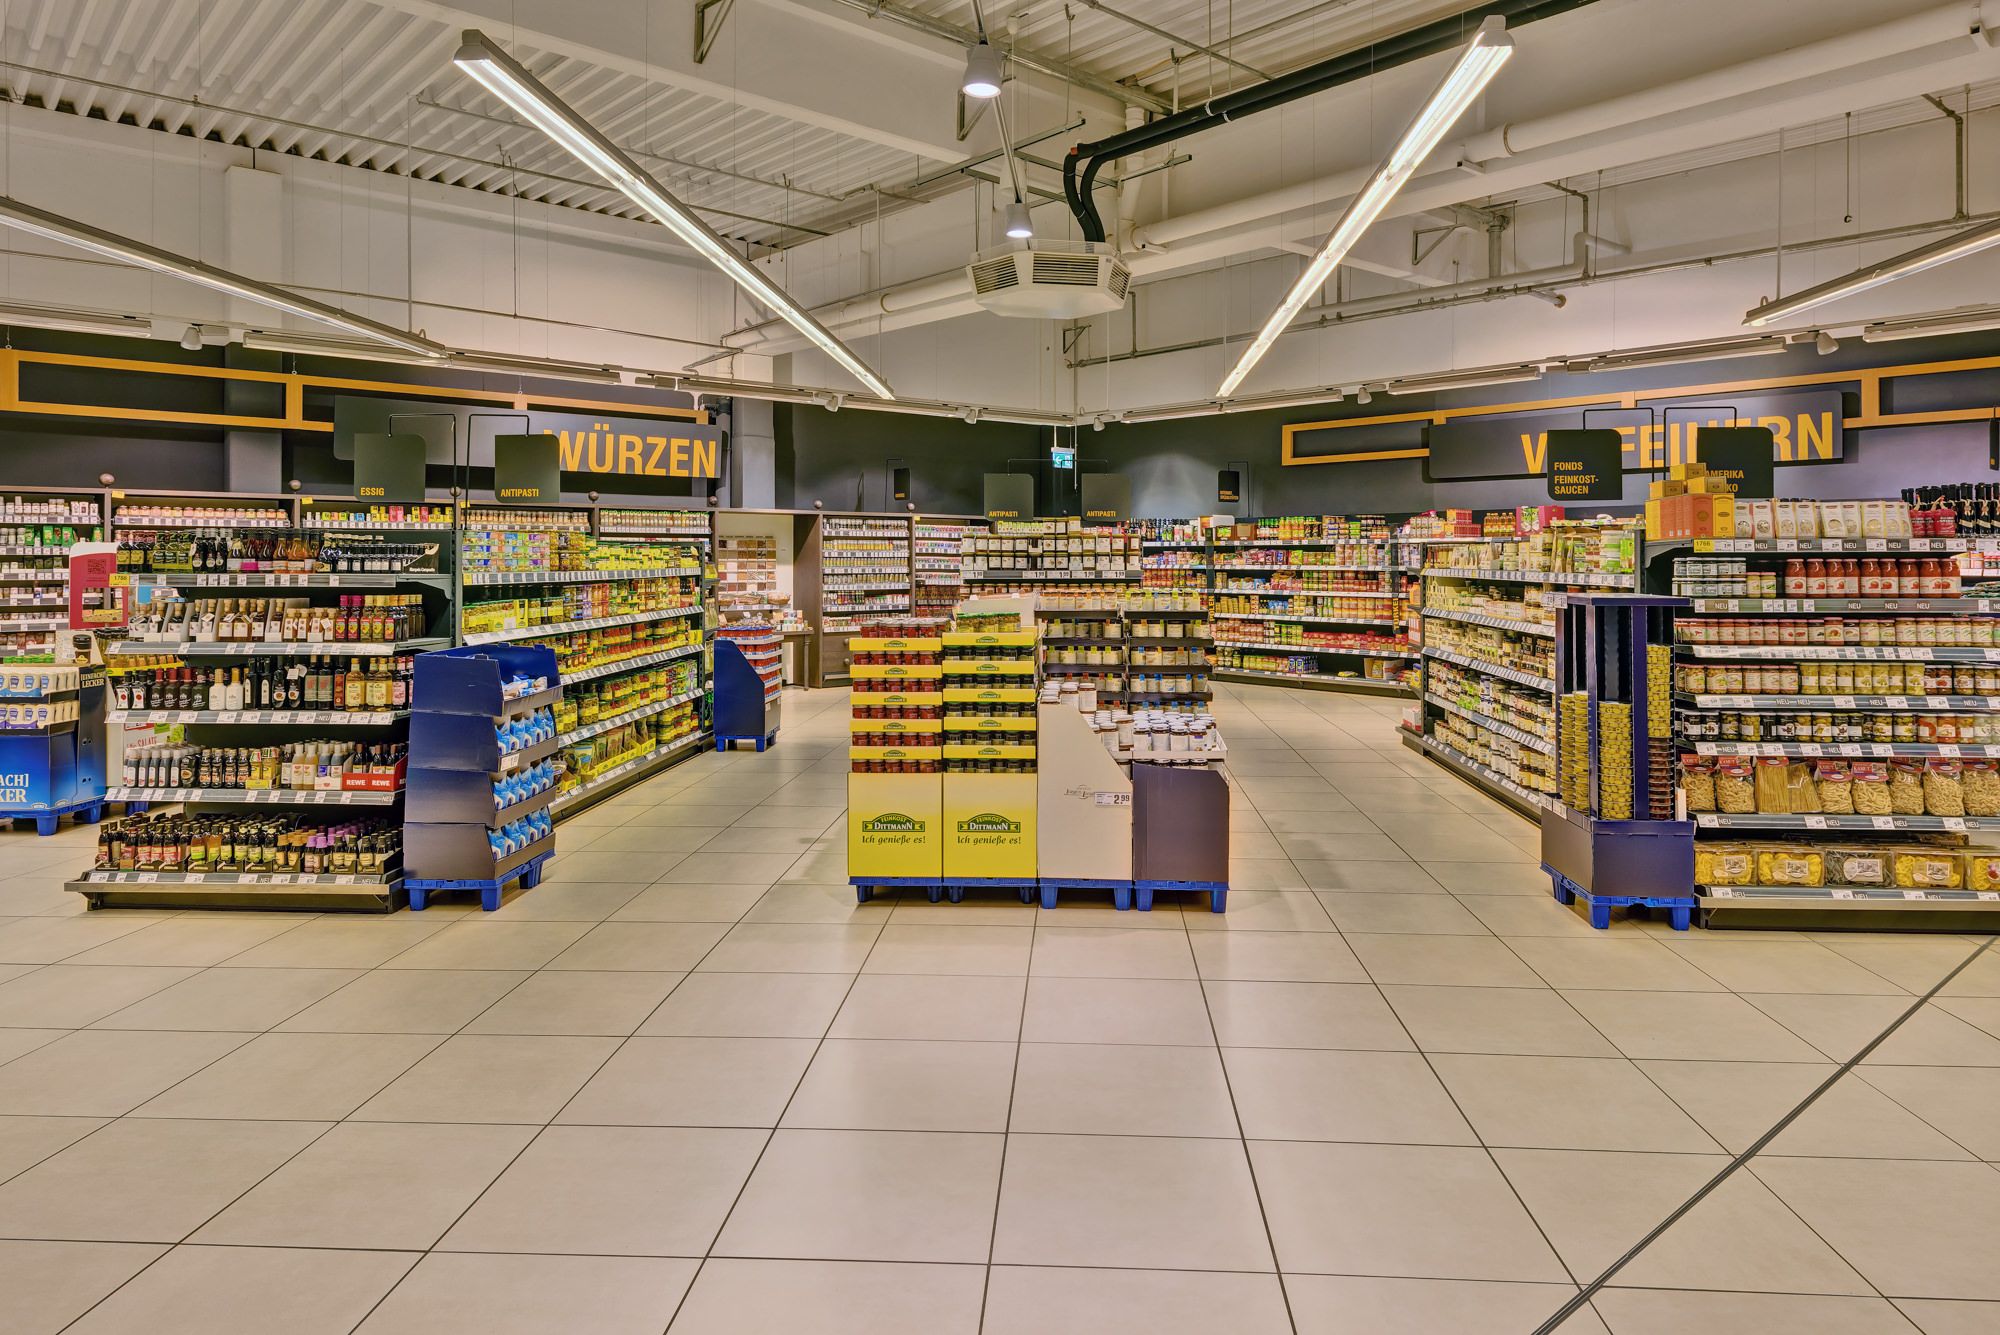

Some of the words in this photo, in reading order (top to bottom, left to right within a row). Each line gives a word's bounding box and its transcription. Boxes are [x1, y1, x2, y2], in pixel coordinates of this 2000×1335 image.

[1554, 462, 1583, 471] FONDS
[1554, 475, 1599, 484] FEINKOST-
[360, 487, 385, 496] ESSIG
[500, 488, 539, 497] ANTIPASTI
[1554, 485, 1589, 495] SAUCEN
[82, 678, 105, 688] LECKER
[1113, 794, 1130, 805] 2.99
[874, 822, 912, 830] DITTMANN
[969, 822, 1008, 830] DITTMANN
[862, 835, 875, 844] Ich
[878, 835, 911, 845] genieße
[914, 836, 926, 844] es!
[957, 835, 970, 844] Ich
[973, 835, 1006, 845] genieße
[1009, 836, 1021, 844] es!
